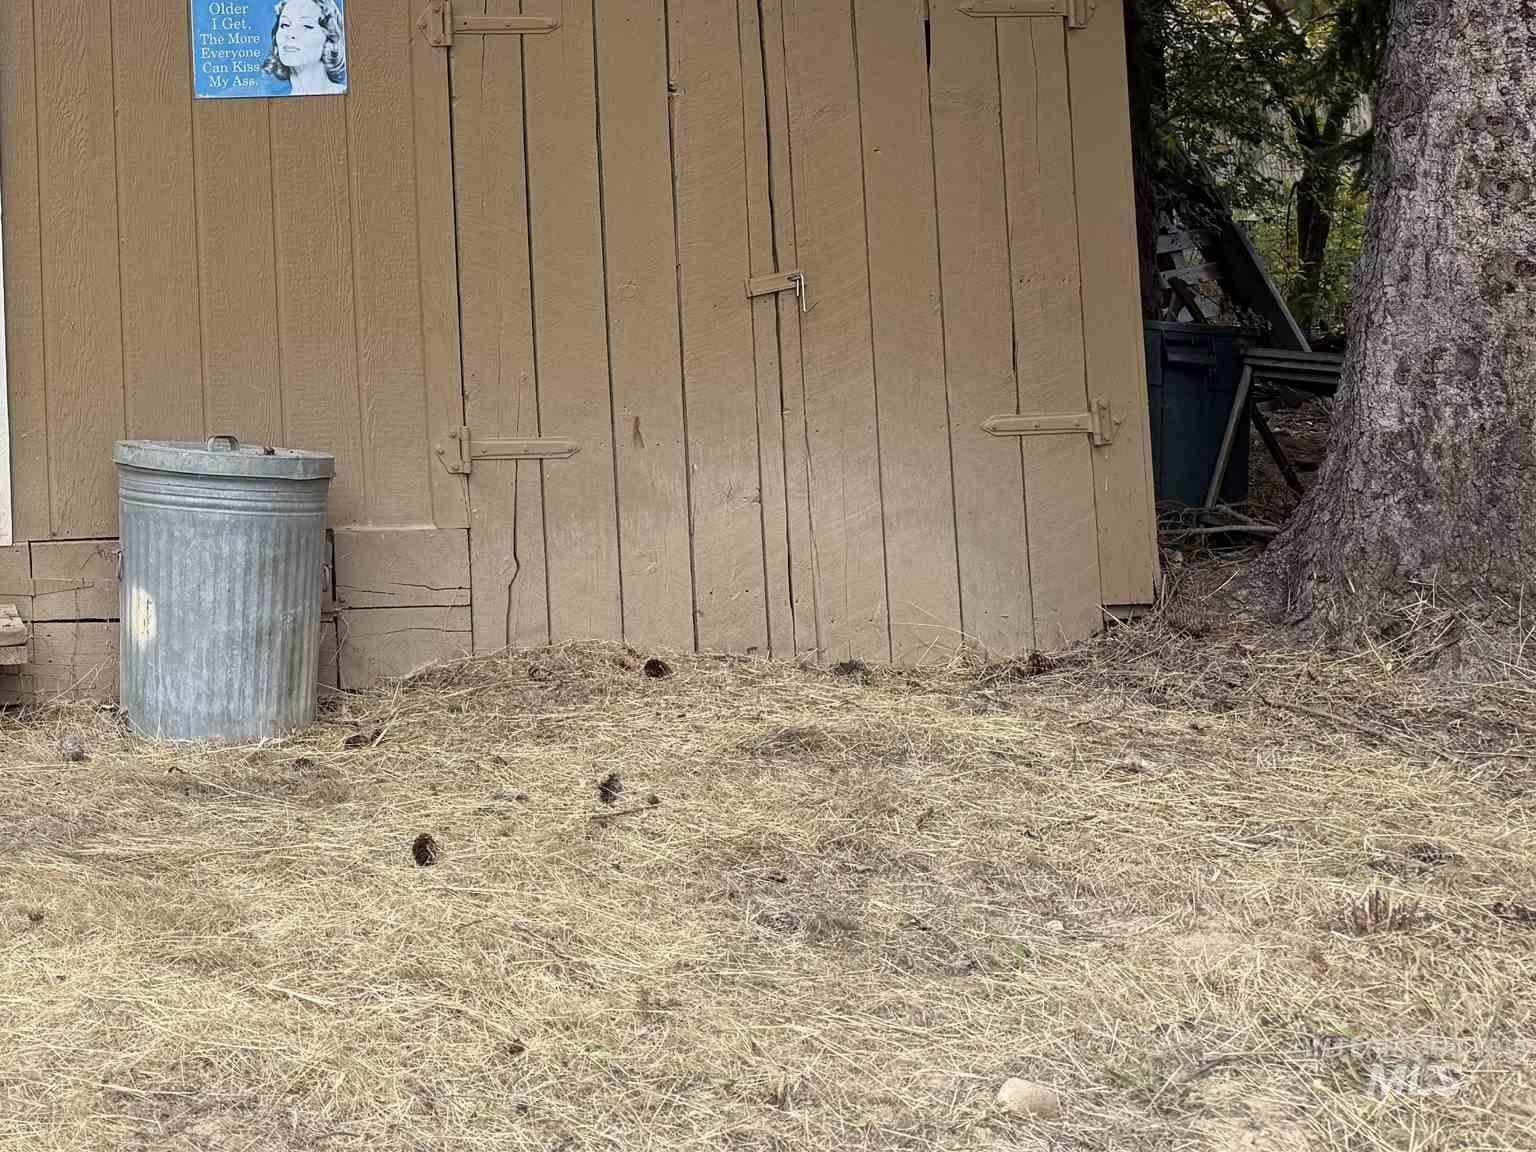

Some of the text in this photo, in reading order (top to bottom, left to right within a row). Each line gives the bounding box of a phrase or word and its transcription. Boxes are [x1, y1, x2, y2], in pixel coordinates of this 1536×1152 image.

[208, 2, 249, 15] Older
[211, 17, 217, 30] I
[199, 32, 260, 45] The More
[199, 47, 261, 60] Everyone
[202, 61, 261, 73] Can Kiss
[208, 75, 230, 88] My
